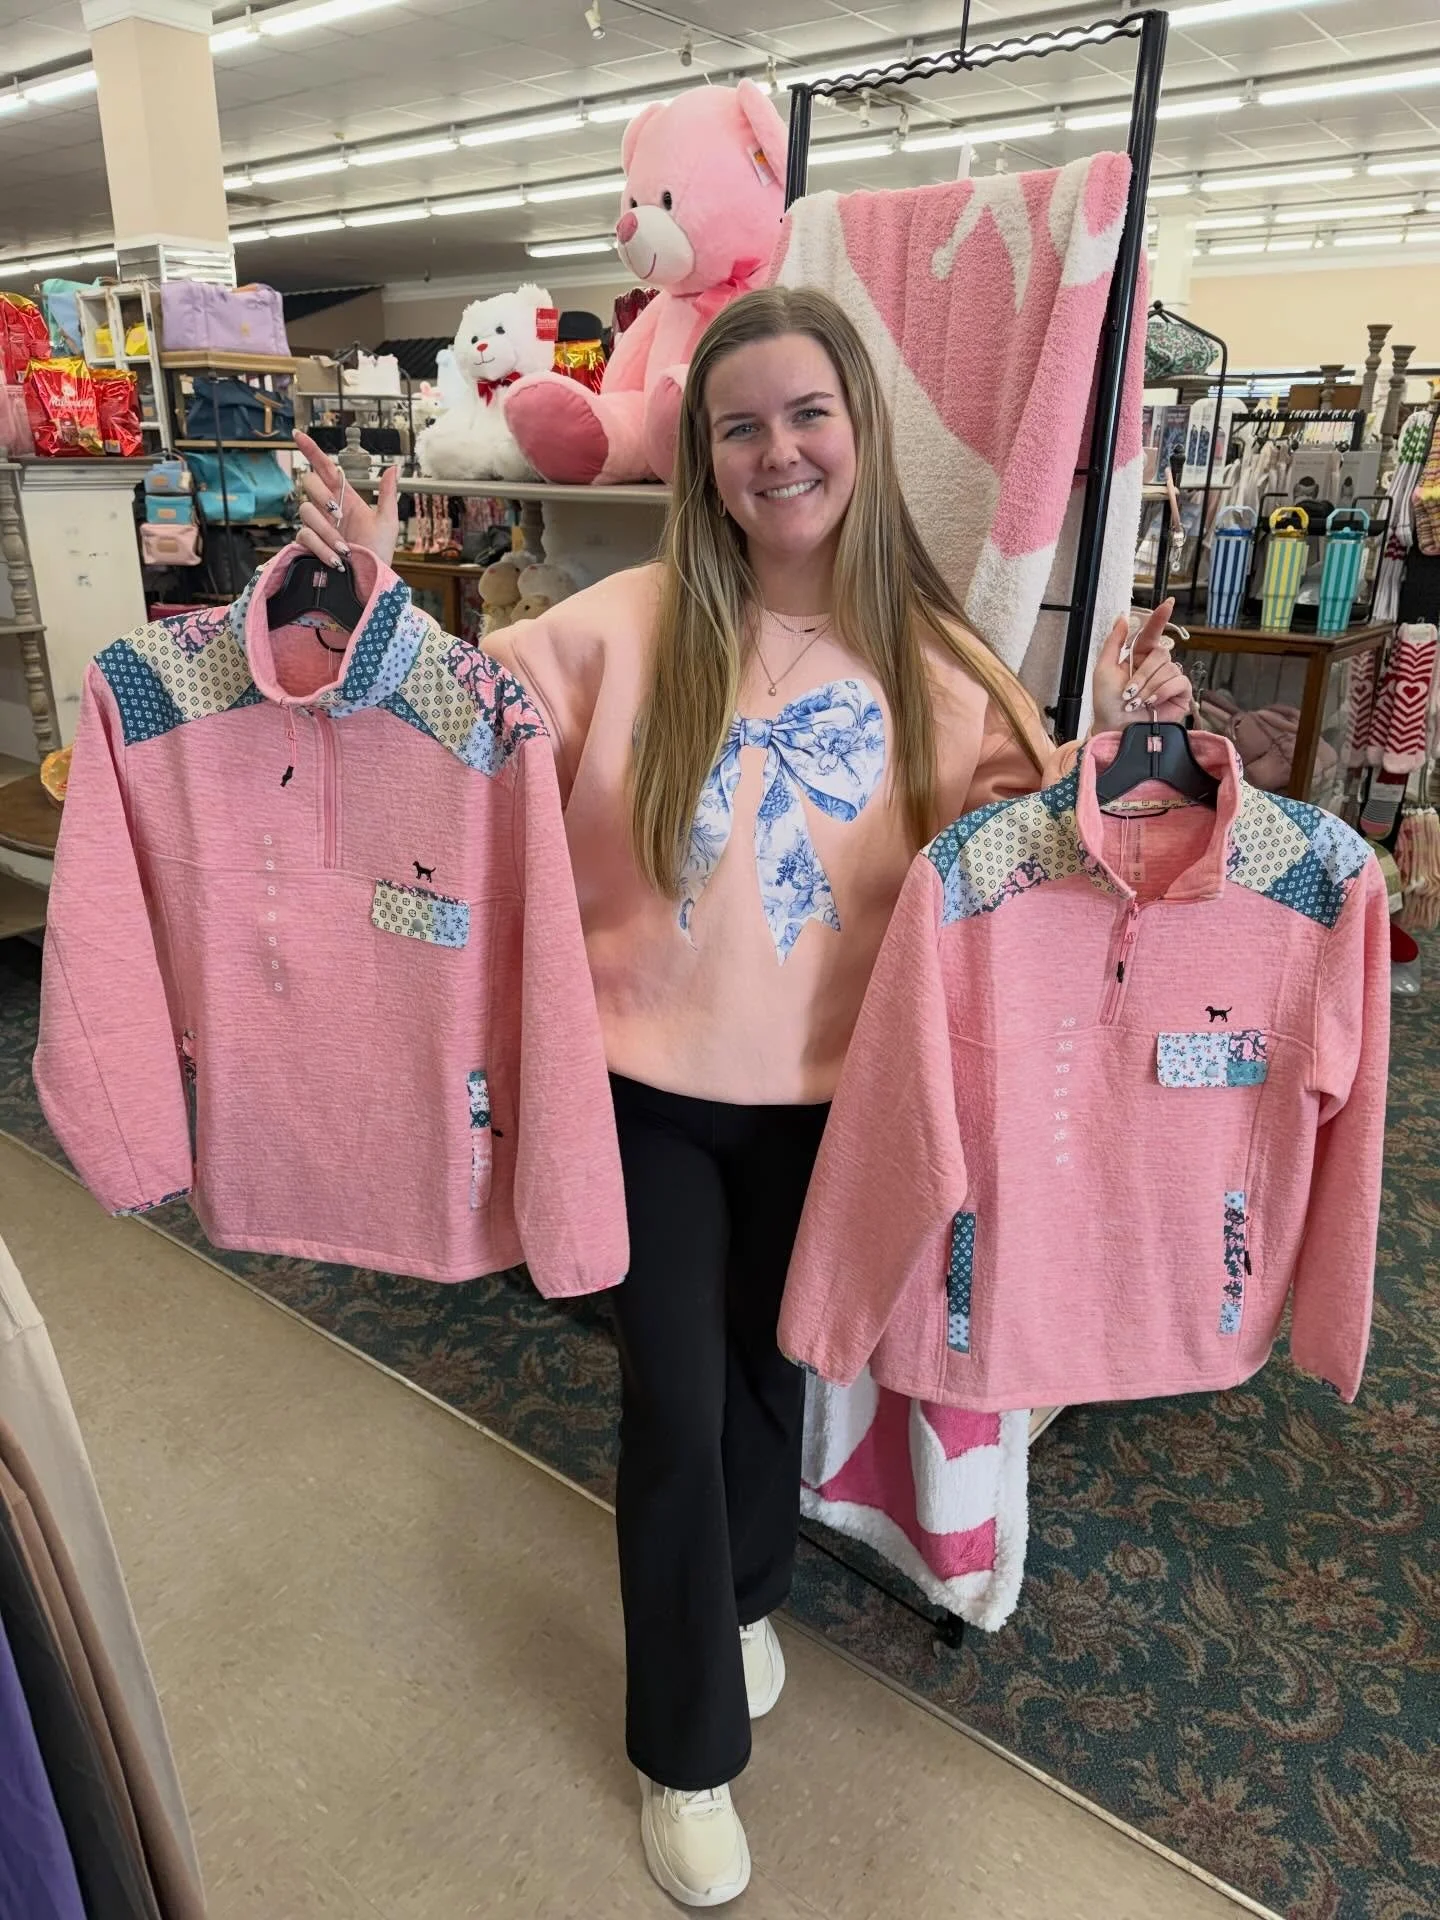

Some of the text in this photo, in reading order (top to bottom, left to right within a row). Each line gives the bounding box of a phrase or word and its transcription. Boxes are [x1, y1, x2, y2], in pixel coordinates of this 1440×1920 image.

[263, 834, 271, 845] S
[265, 860, 273, 870] S
[267, 885, 275, 895] S
[267, 911, 275, 921] S
[268, 936, 276, 946] S
[271, 960, 279, 970] S
[274, 981, 283, 991] S
[1062, 1017, 1076, 1028] XS
[1058, 1041, 1073, 1051] XS
[1056, 1064, 1070, 1074] XS
[1054, 1088, 1068, 1097] XS
